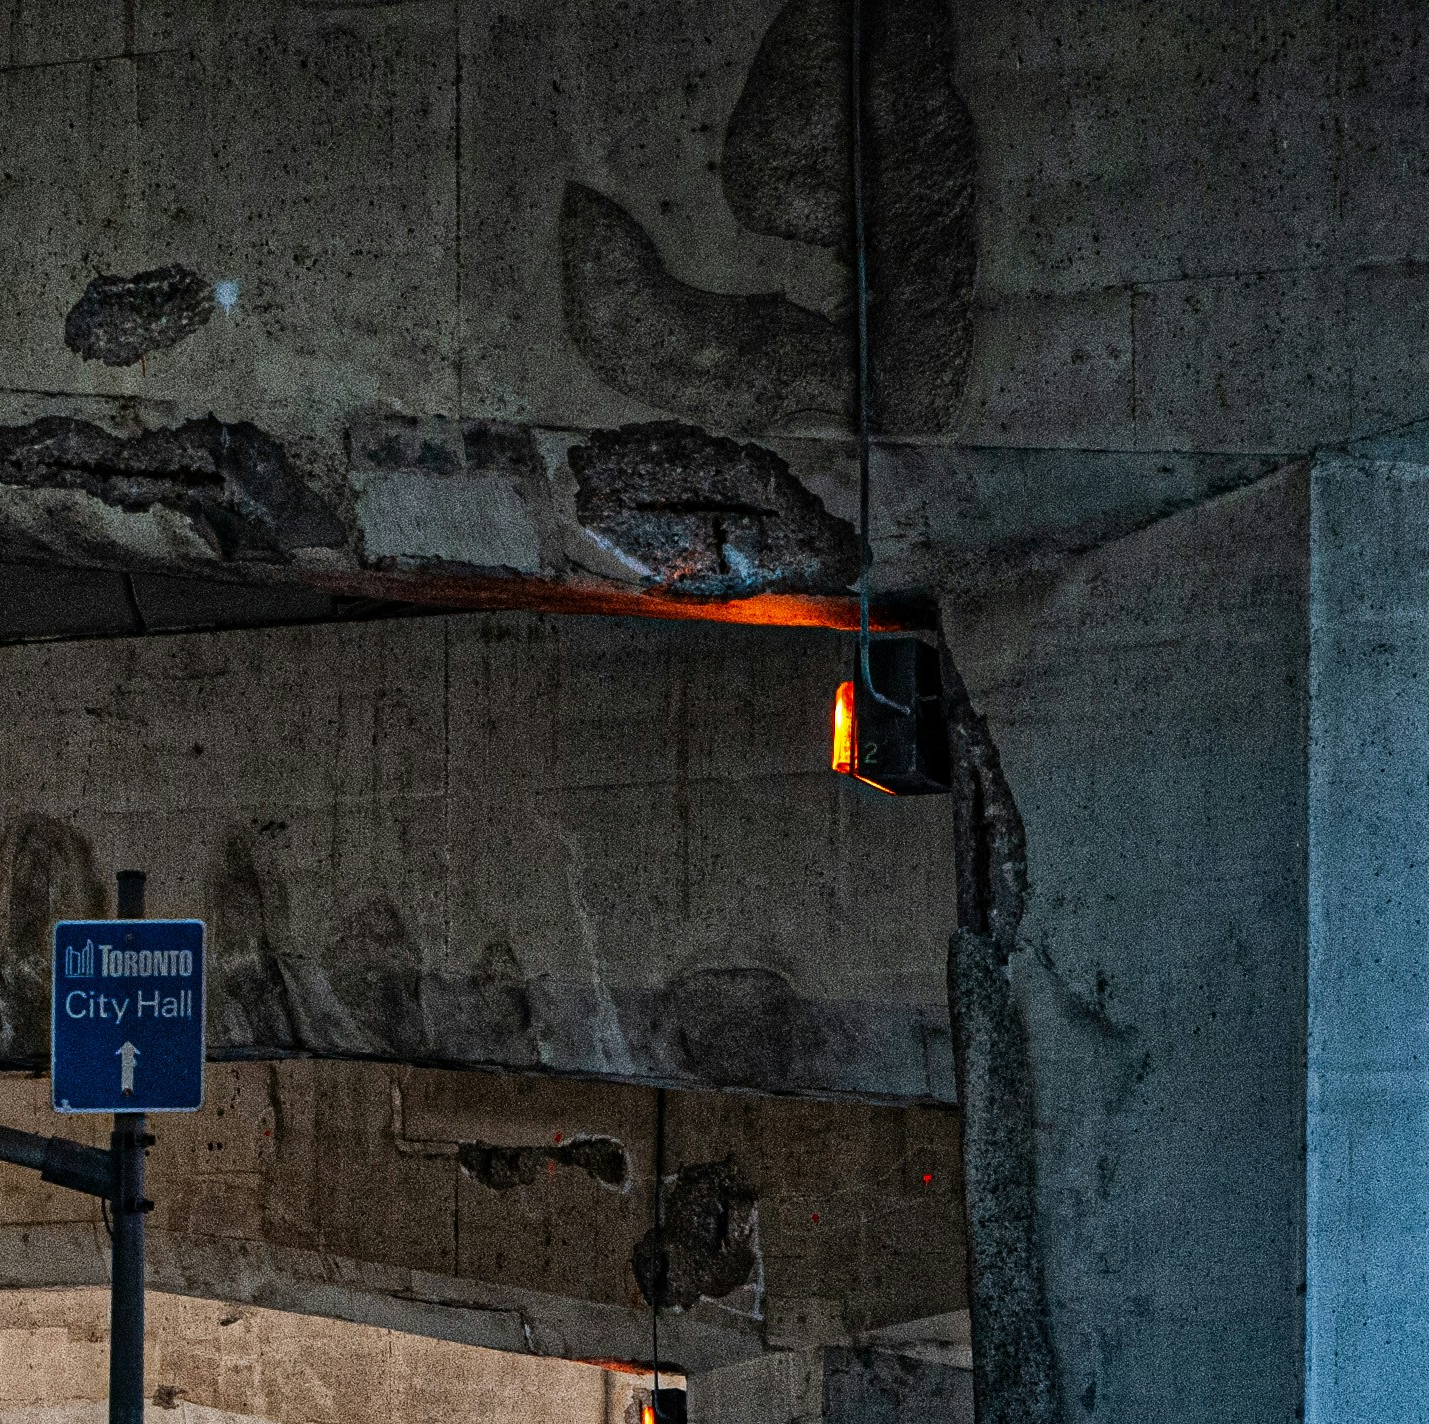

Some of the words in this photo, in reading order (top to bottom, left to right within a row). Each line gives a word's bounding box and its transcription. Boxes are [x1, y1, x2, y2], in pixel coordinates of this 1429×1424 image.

[864, 742, 878, 763] 2
[99, 944, 193, 977] TORONTO
[65, 990, 129, 1025] City
[138, 990, 192, 1018] Hall
